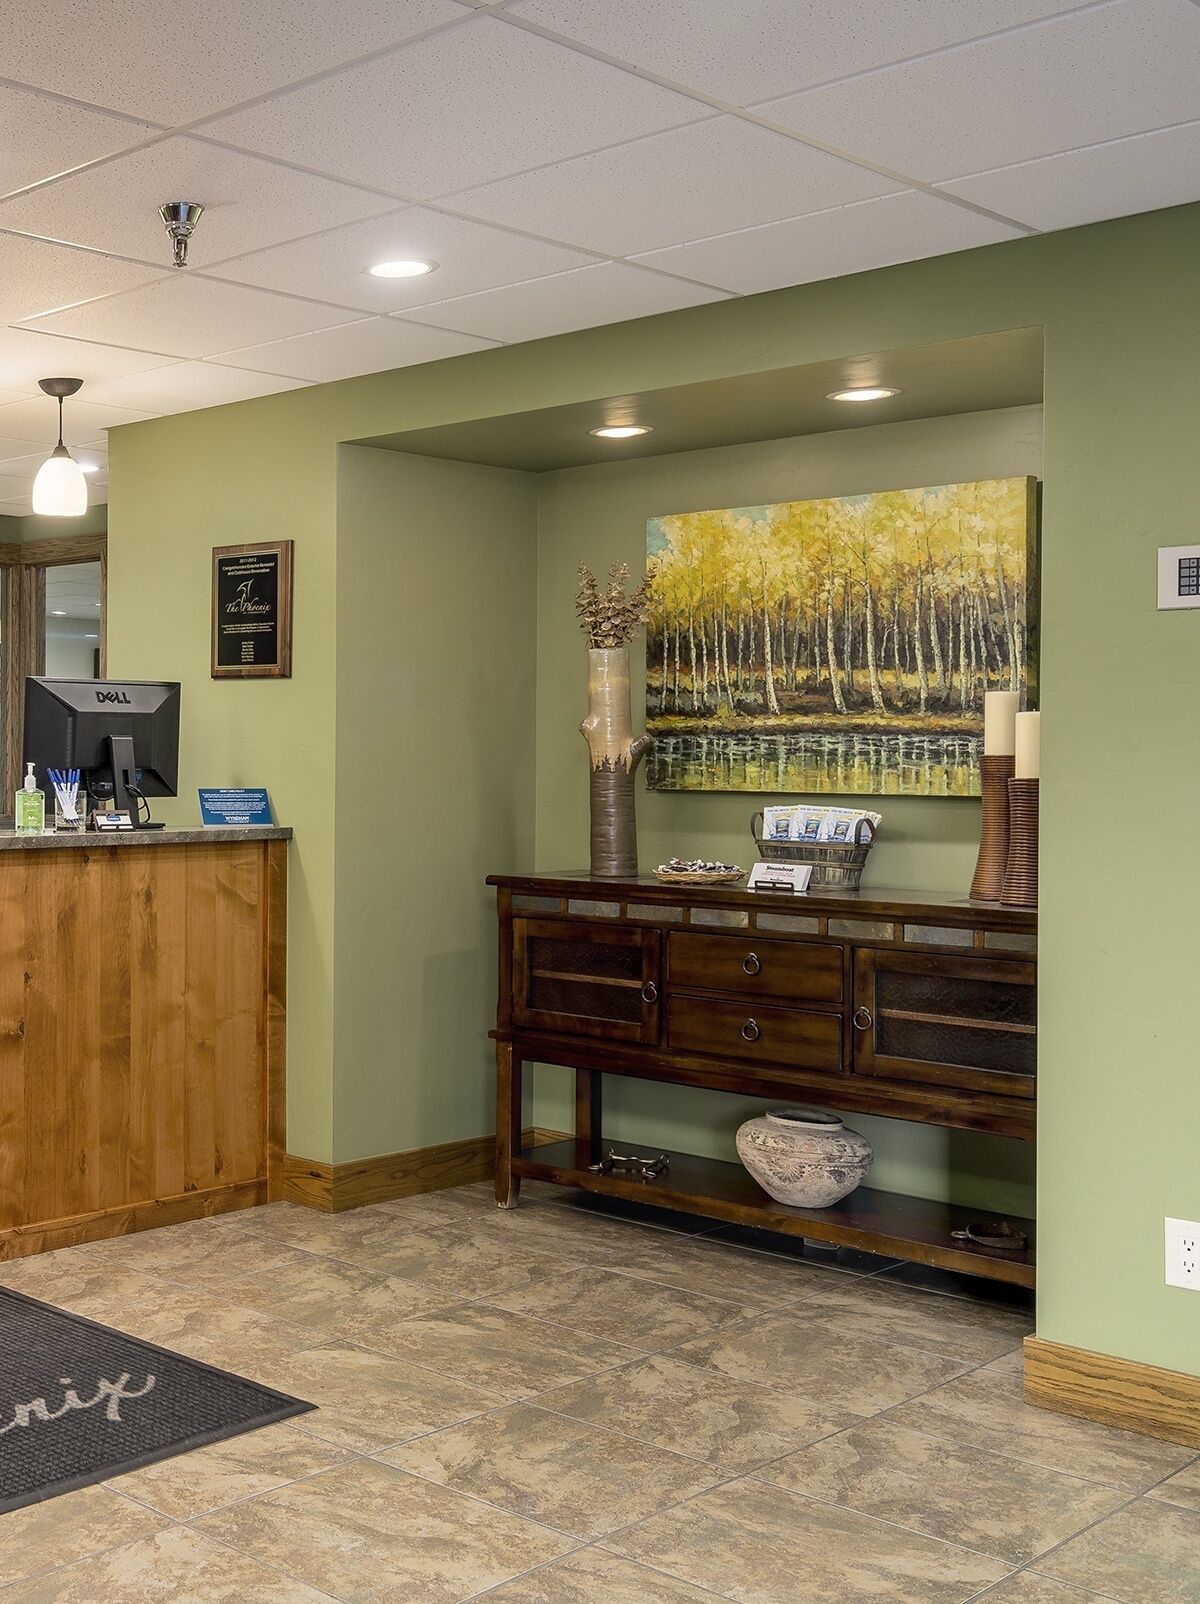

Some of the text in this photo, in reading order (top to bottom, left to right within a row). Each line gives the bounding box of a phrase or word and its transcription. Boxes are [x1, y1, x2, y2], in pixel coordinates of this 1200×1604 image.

[225, 597, 271, 614] The Phoenix
[95, 691, 131, 704] DELL
